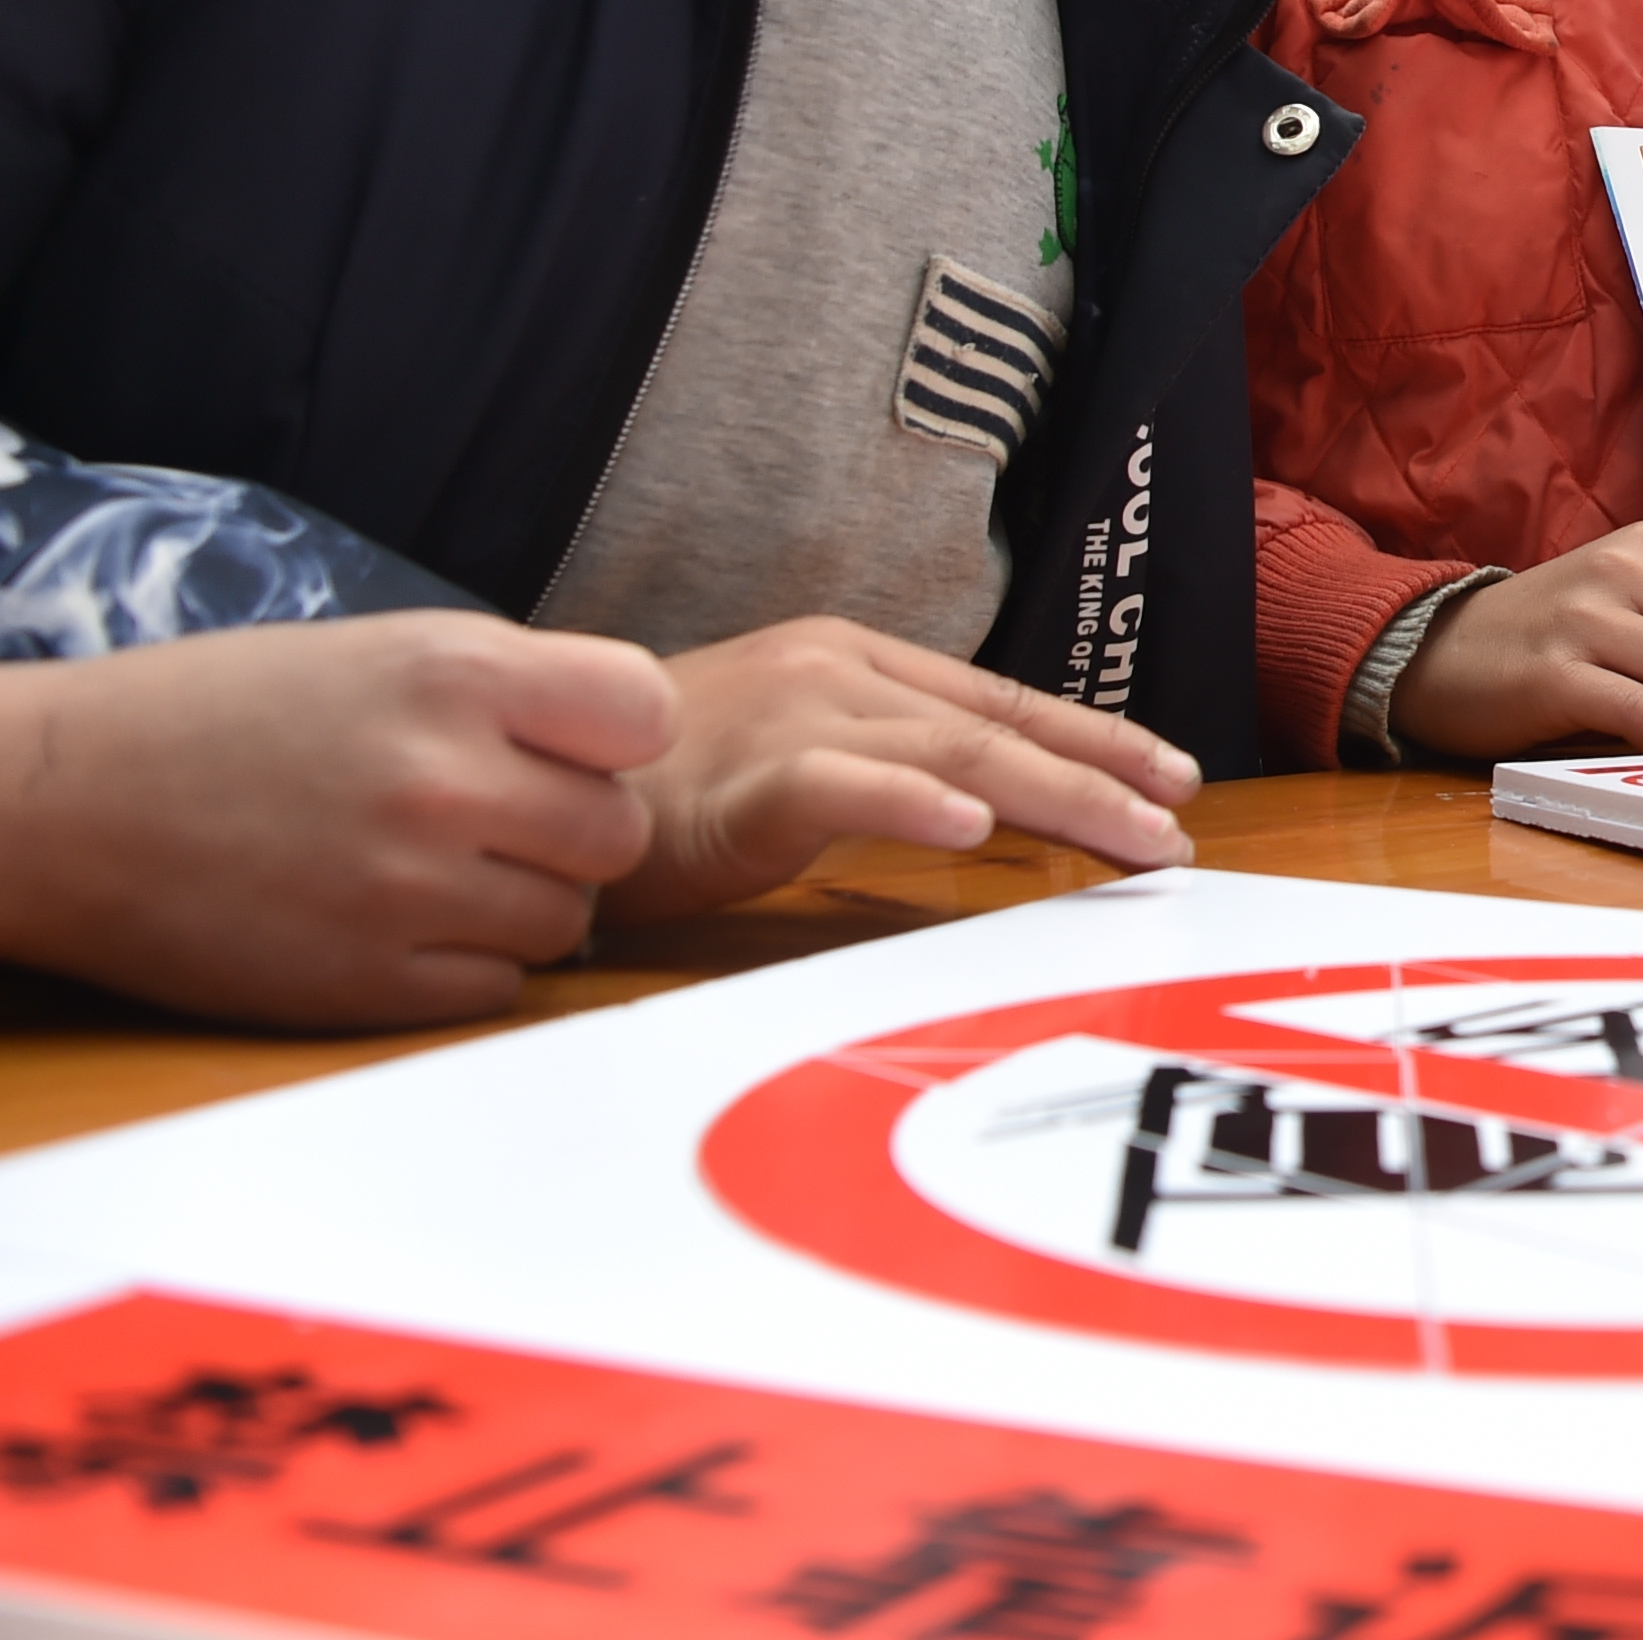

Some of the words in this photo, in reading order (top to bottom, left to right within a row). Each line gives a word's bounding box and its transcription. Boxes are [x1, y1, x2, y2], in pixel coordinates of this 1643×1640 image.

[1083, 519, 1111, 568] THE
[1077, 574, 1105, 636] KING
[1066, 641, 1093, 672] OF
